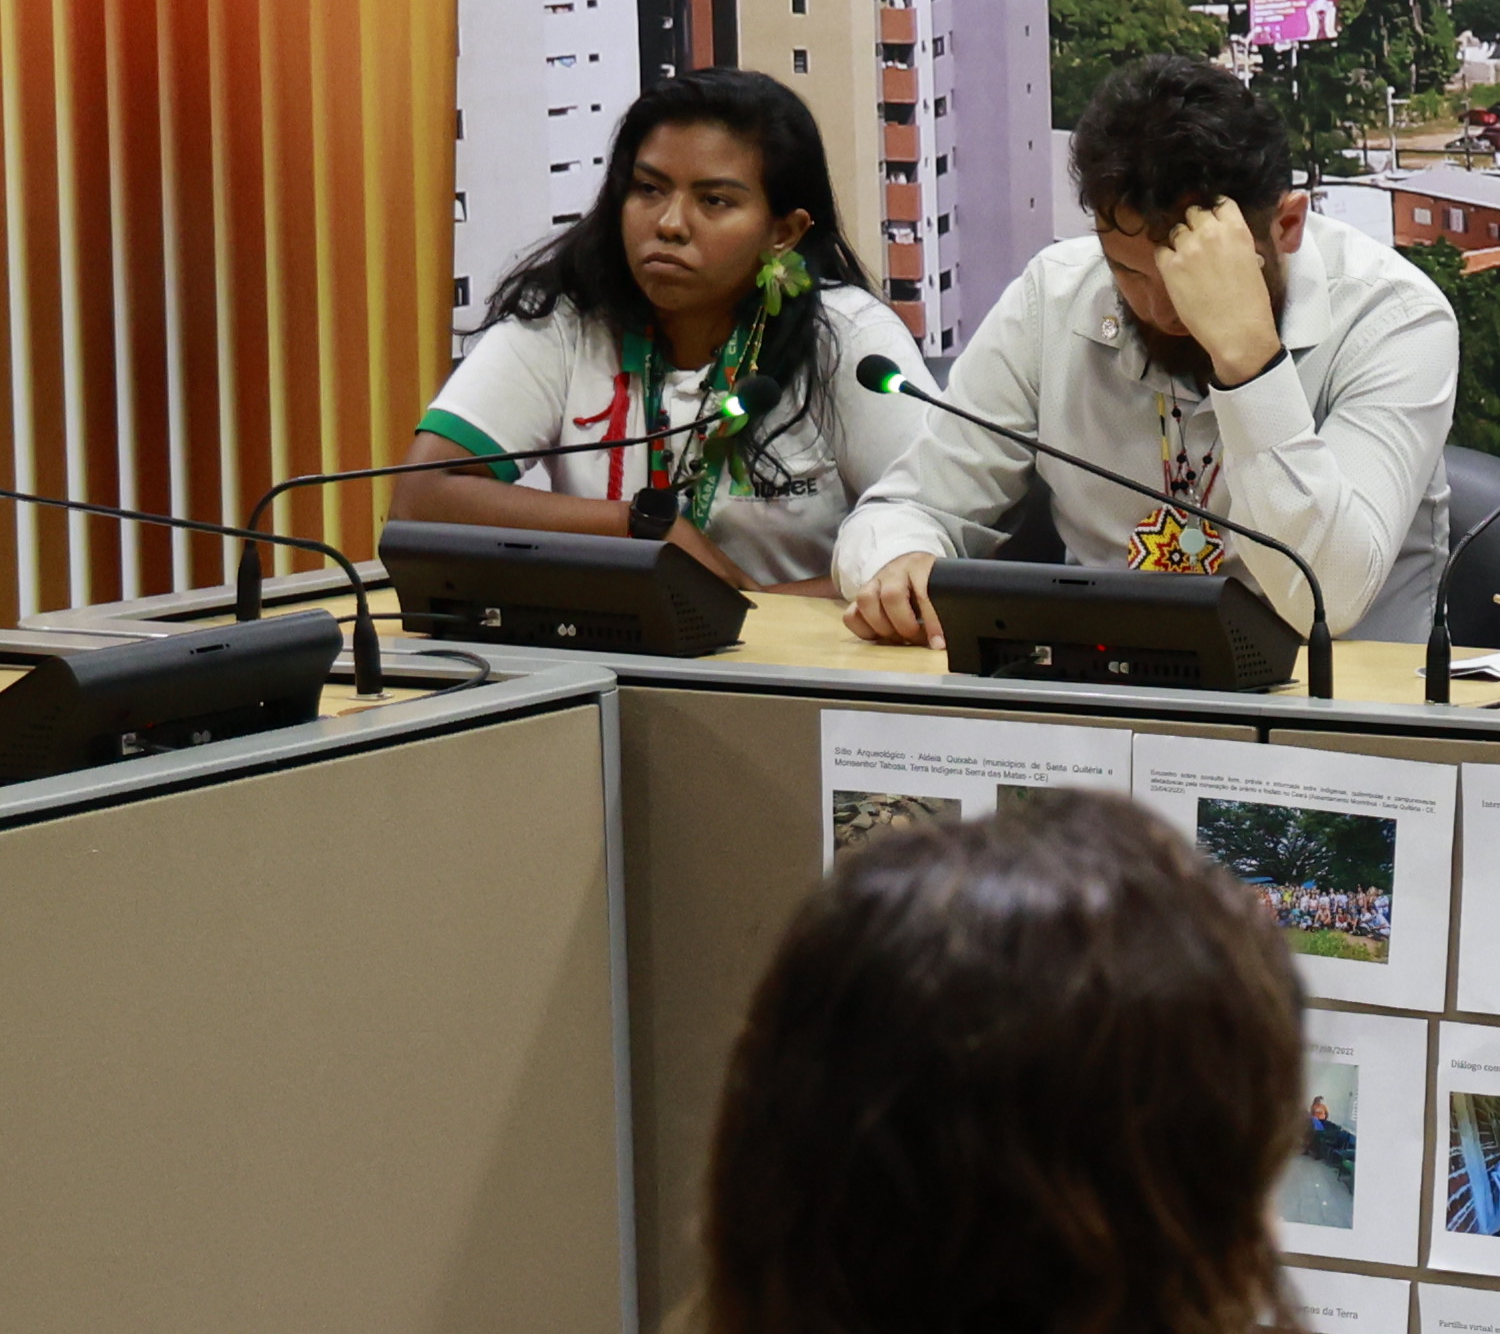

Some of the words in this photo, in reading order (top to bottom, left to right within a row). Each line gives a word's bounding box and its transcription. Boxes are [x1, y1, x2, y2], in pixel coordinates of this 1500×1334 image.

[834, 757, 877, 769] Monsenhor
[910, 763, 929, 773] Terra
[965, 767, 986, 777] Serra
[988, 769, 1001, 779] das
[1003, 771, 1027, 780] Matas
[1033, 773, 1049, 783] CE)
[917, 752, 942, 763] Aldeia
[946, 754, 978, 765] Quixaba
[1030, 761, 1041, 770] de
[1046, 762, 1068, 772] Santa
[1072, 763, 1103, 775] Quitéria
[1451, 1059, 1482, 1072] Diálogo
[1484, 1064, 1500, 1072] com
[1322, 1307, 1333, 1316] da
[1336, 1308, 1358, 1319] Terra
[1438, 1319, 1468, 1330] Partilha
[1469, 1323, 1493, 1333] virtual
